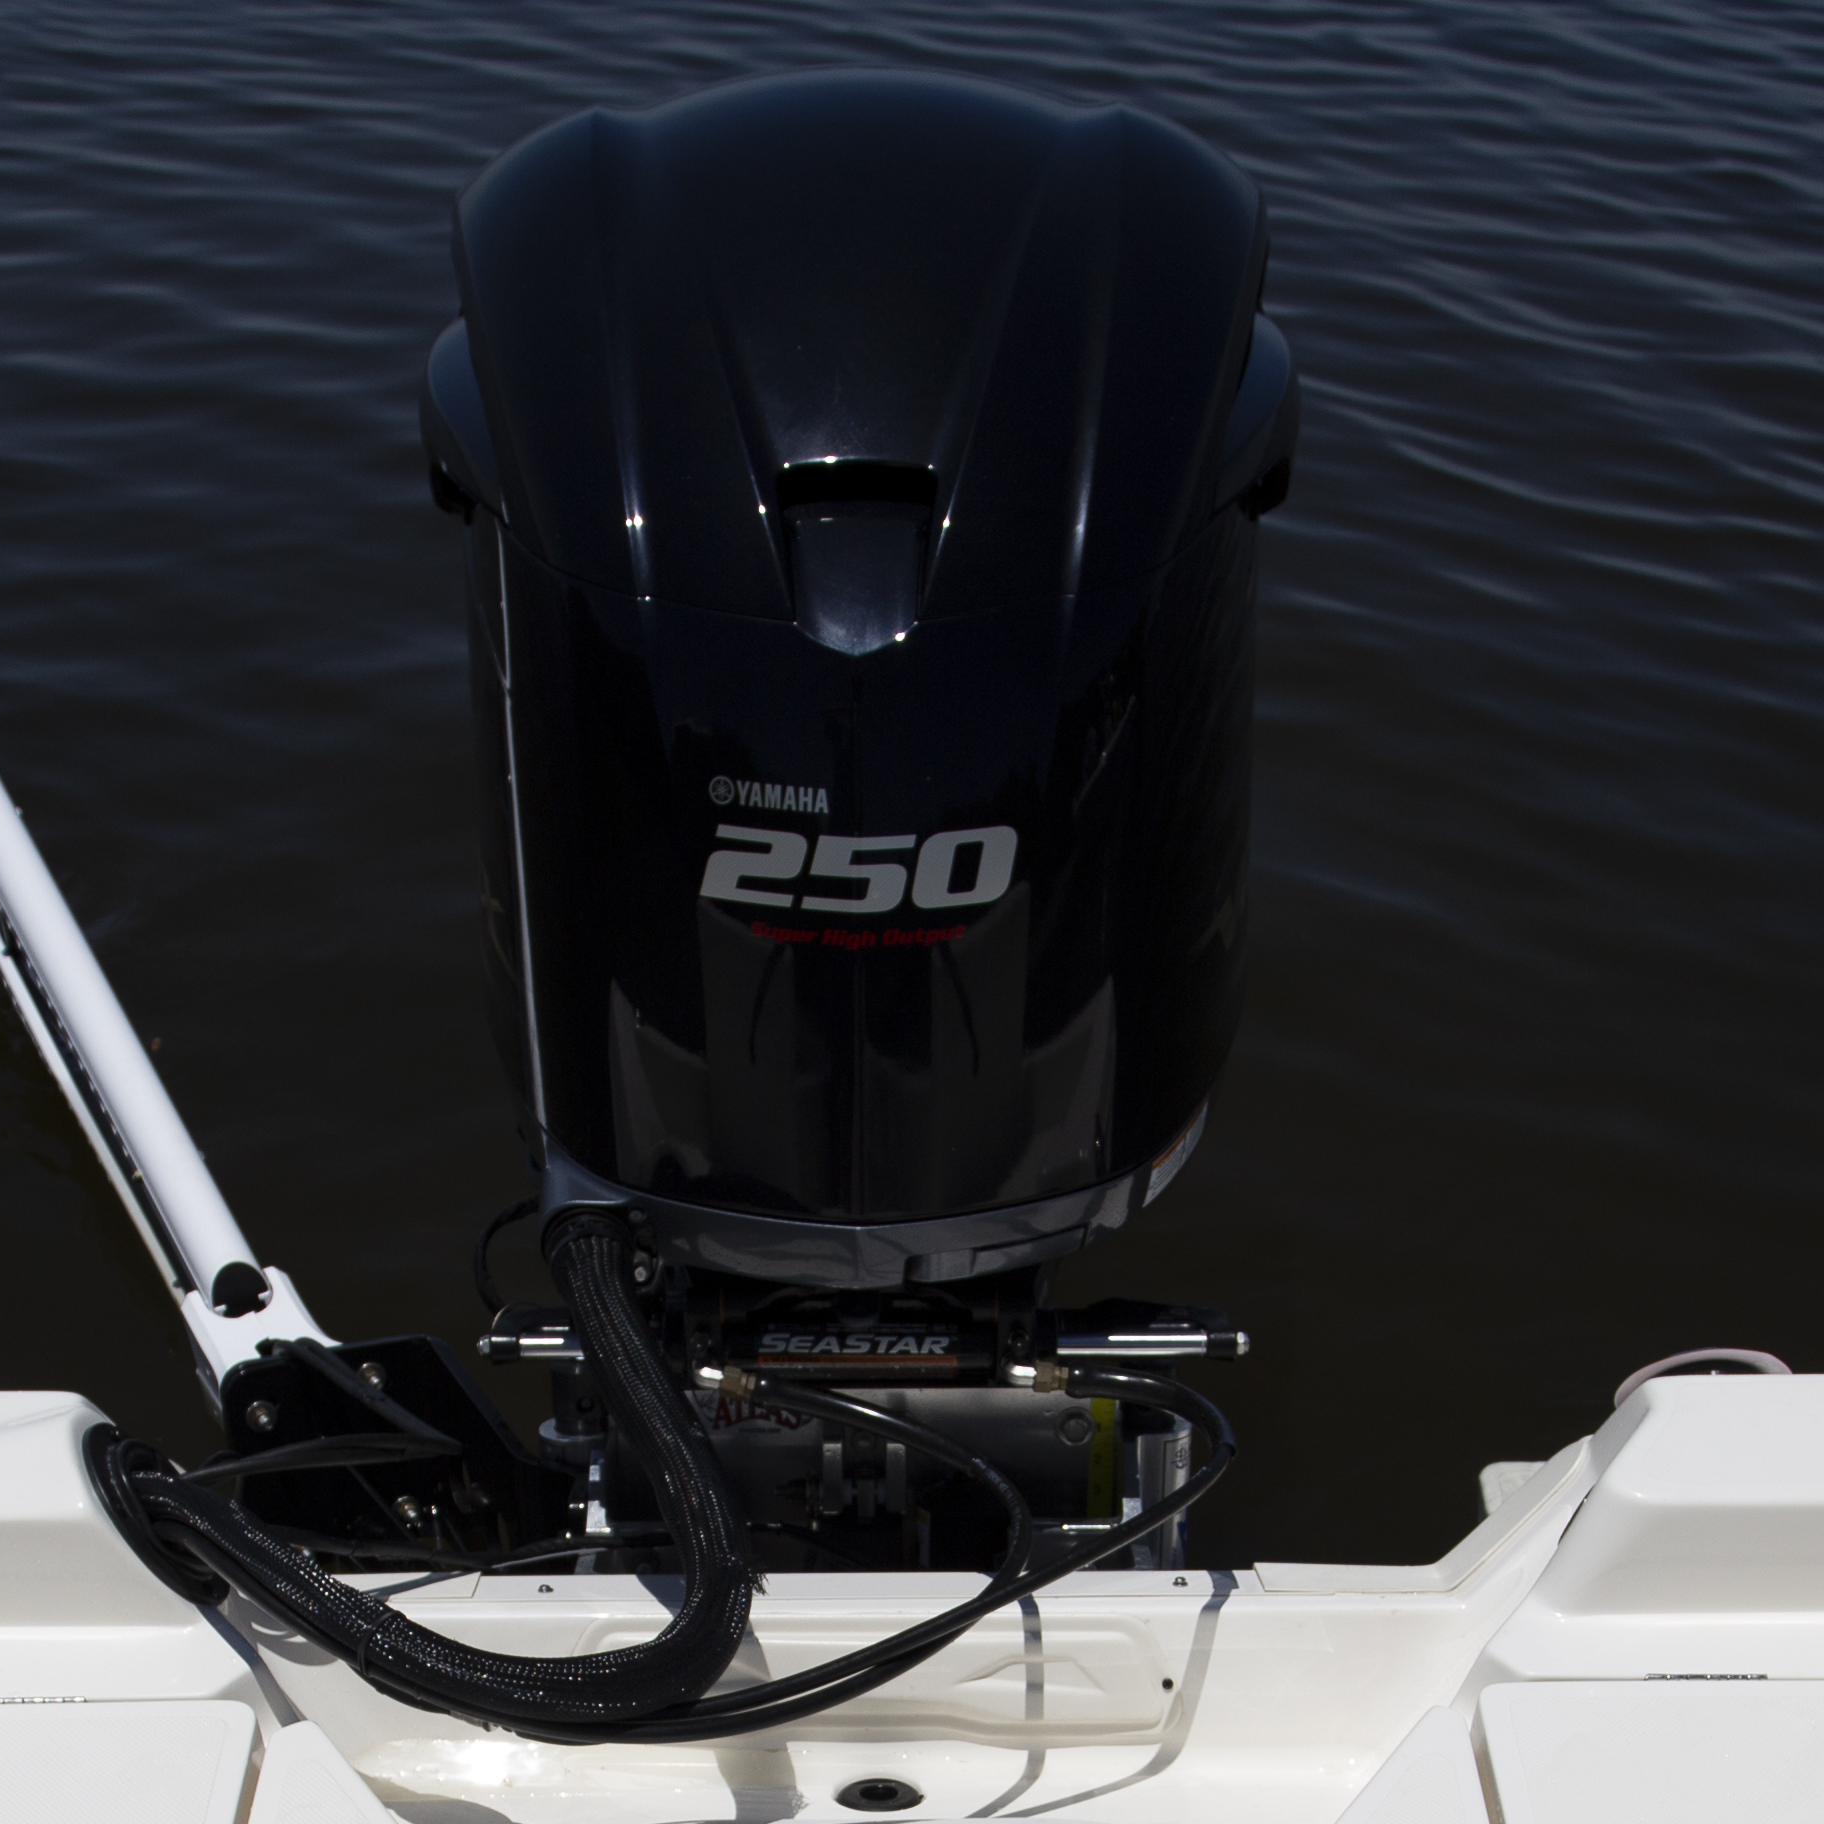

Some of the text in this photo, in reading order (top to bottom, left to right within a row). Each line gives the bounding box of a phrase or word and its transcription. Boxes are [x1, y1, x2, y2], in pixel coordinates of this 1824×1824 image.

[737, 779, 829, 814] YAMAHA
[699, 824, 1018, 913] 250
[750, 921, 966, 951] Super High Output
